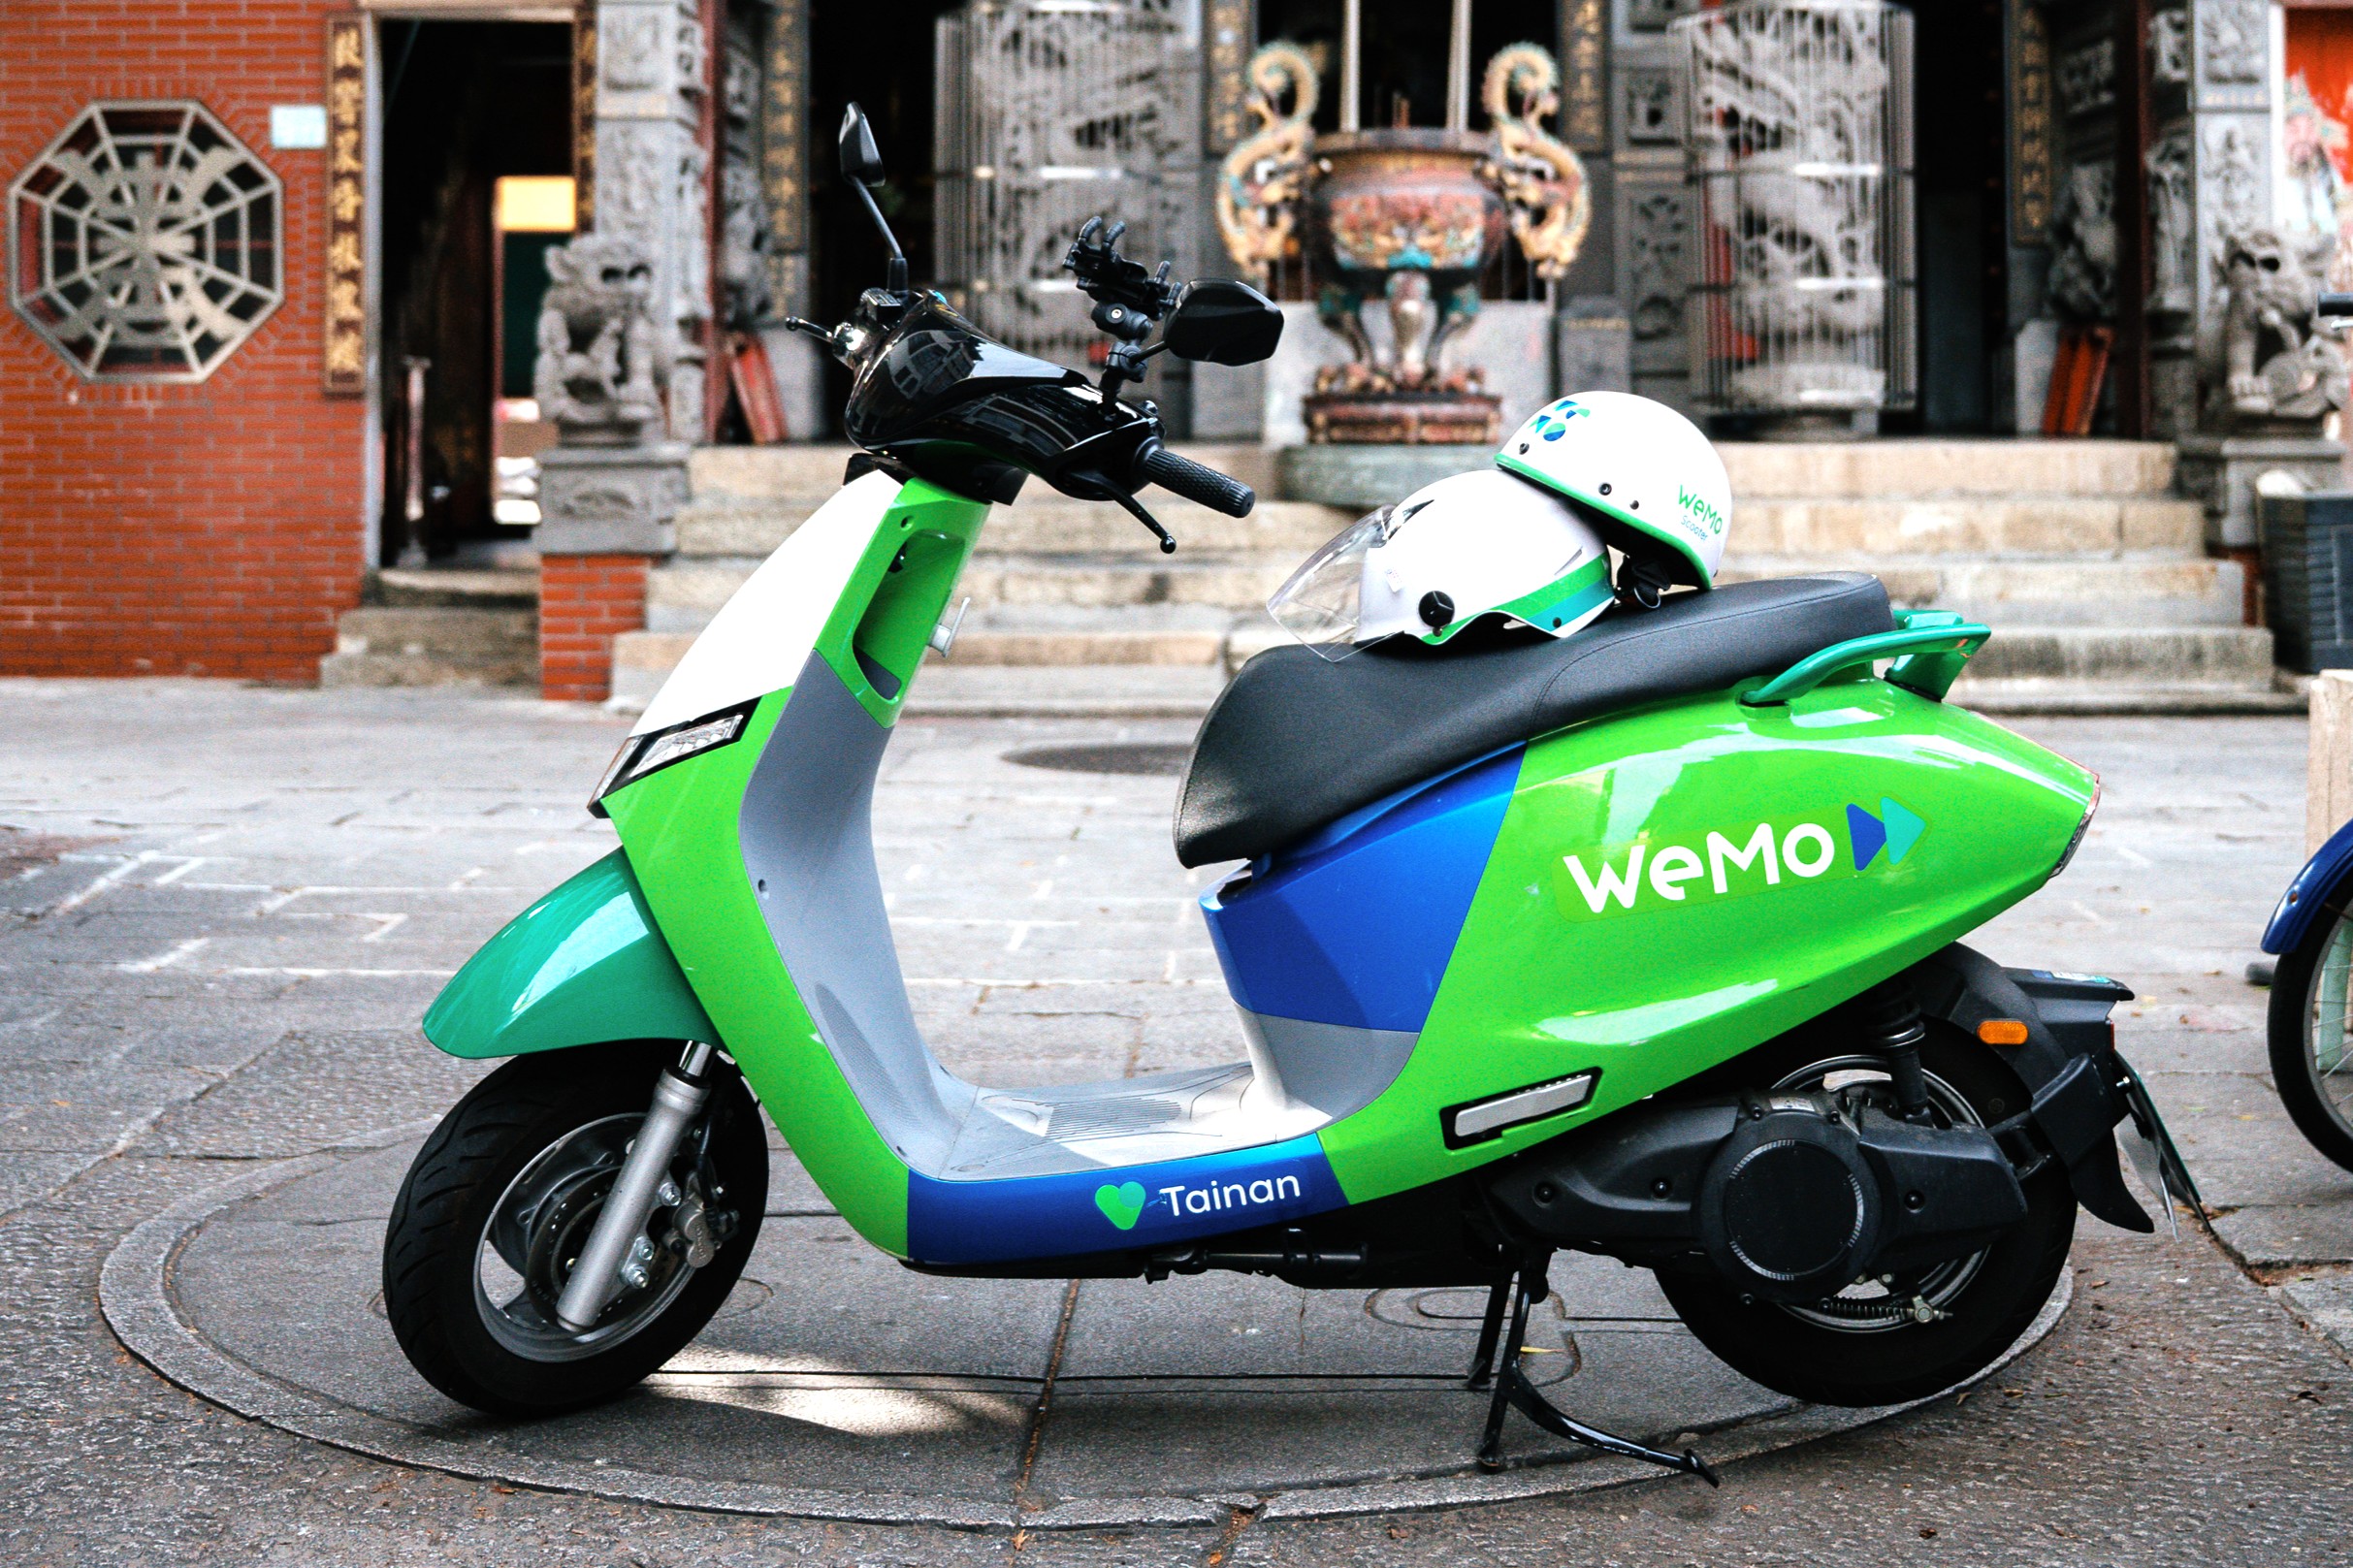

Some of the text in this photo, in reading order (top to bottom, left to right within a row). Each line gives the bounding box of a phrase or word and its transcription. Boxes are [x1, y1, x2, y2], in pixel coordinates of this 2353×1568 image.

[1680, 515, 1709, 541] Scooter
[1563, 822, 1835, 913] WeMo
[1161, 1174, 1301, 1217] Tainan
